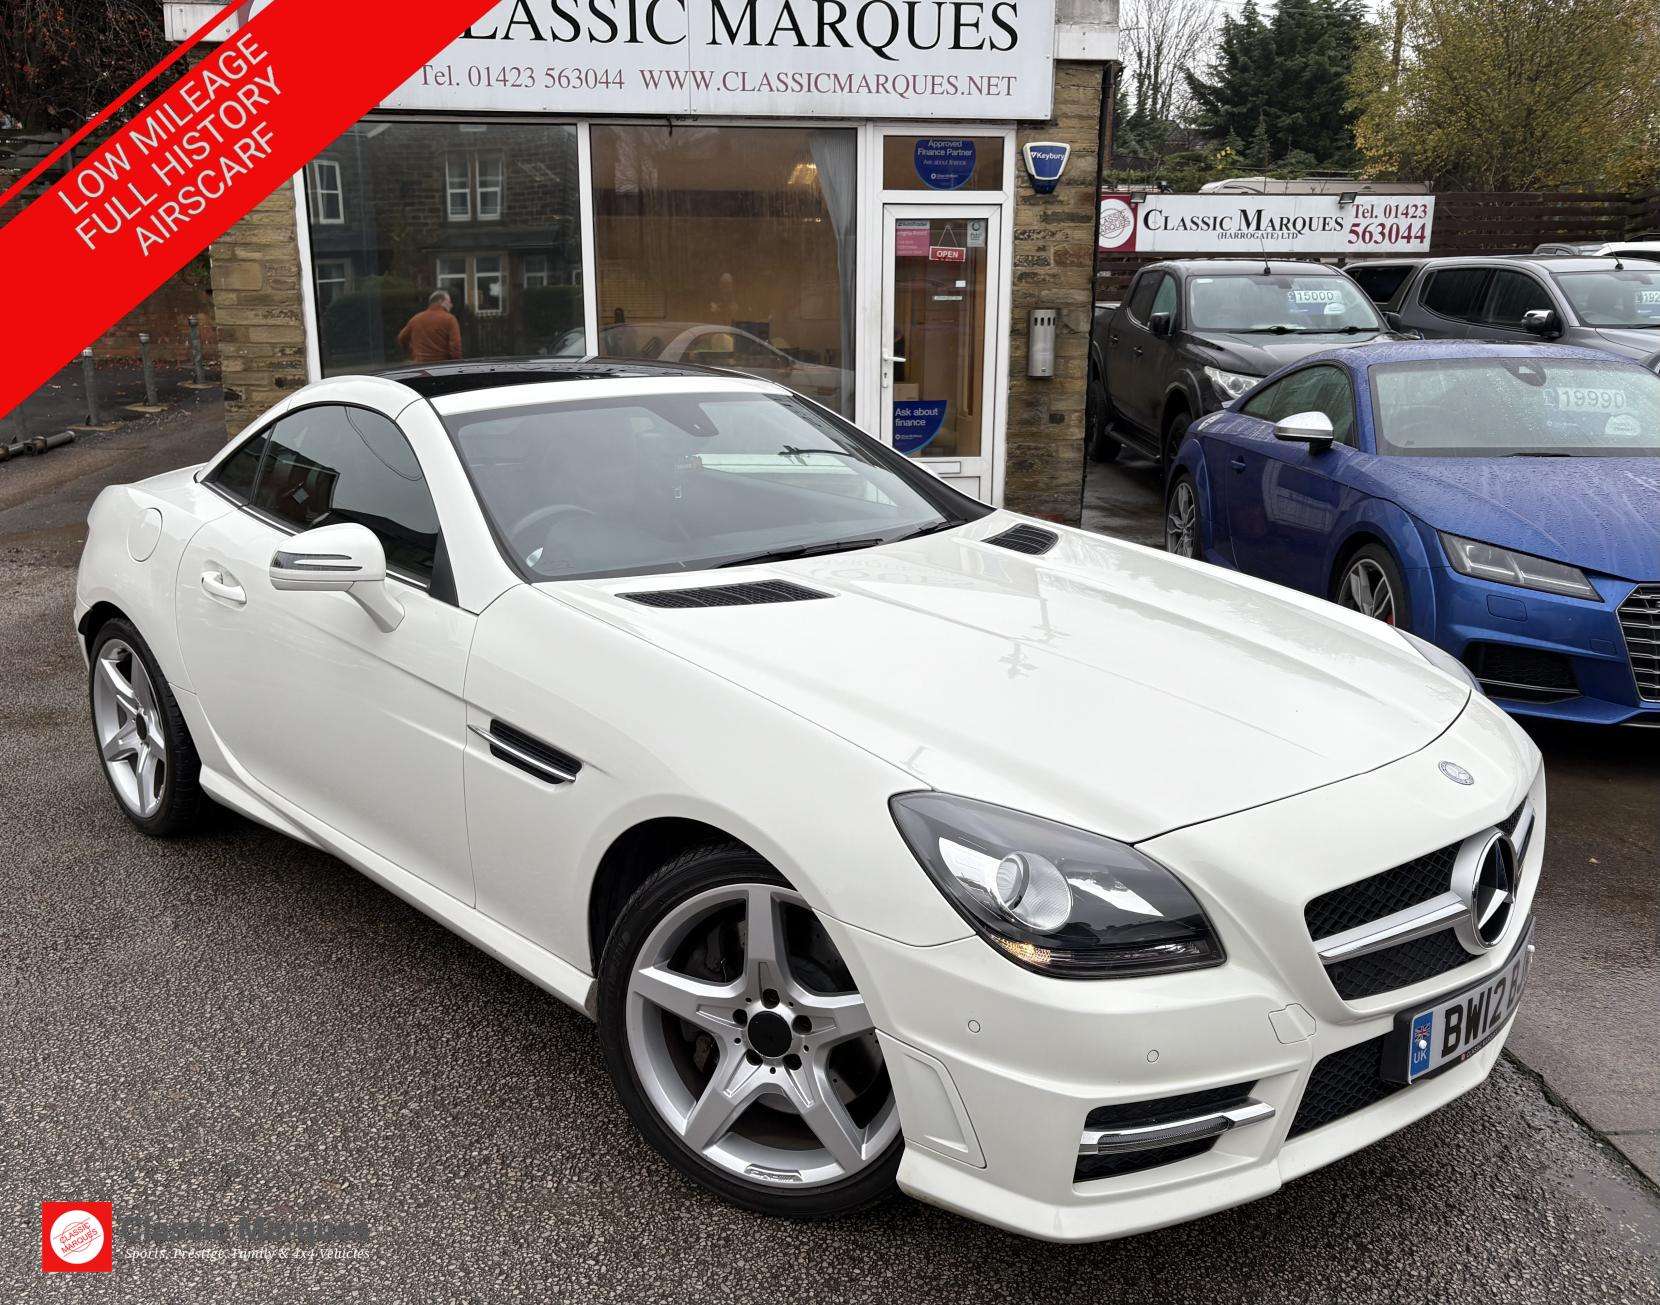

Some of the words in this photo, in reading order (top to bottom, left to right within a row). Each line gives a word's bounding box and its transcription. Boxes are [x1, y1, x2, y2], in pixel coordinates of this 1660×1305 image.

[706, 0, 1019, 61] MARQUES
[420, 65, 460, 86] Tel.
[468, 66, 536, 88] 01423
[545, 67, 625, 89] 563044
[638, 69, 1017, 99] WWW.CLASSICMARQUES.NET
[928, 139, 962, 148] Approved
[917, 148, 946, 156] Finance
[947, 148, 973, 156] Partner
[1037, 152, 1065, 161] Keybury
[1352, 203, 1378, 219] Tel.
[1384, 204, 1427, 219] 01423
[1143, 209, 1233, 231] CLASSIC
[1238, 209, 1344, 236] MARQUES
[1217, 232, 1279, 241] (HARROGATE)
[1281, 232, 1298, 240] LTD
[1347, 222, 1426, 244] 563044
[936, 250, 959, 259] OPEN
[895, 408, 911, 416] Ask
[913, 408, 938, 416] about
[895, 418, 926, 427] finance
[1413, 1050, 1427, 1063] UK
